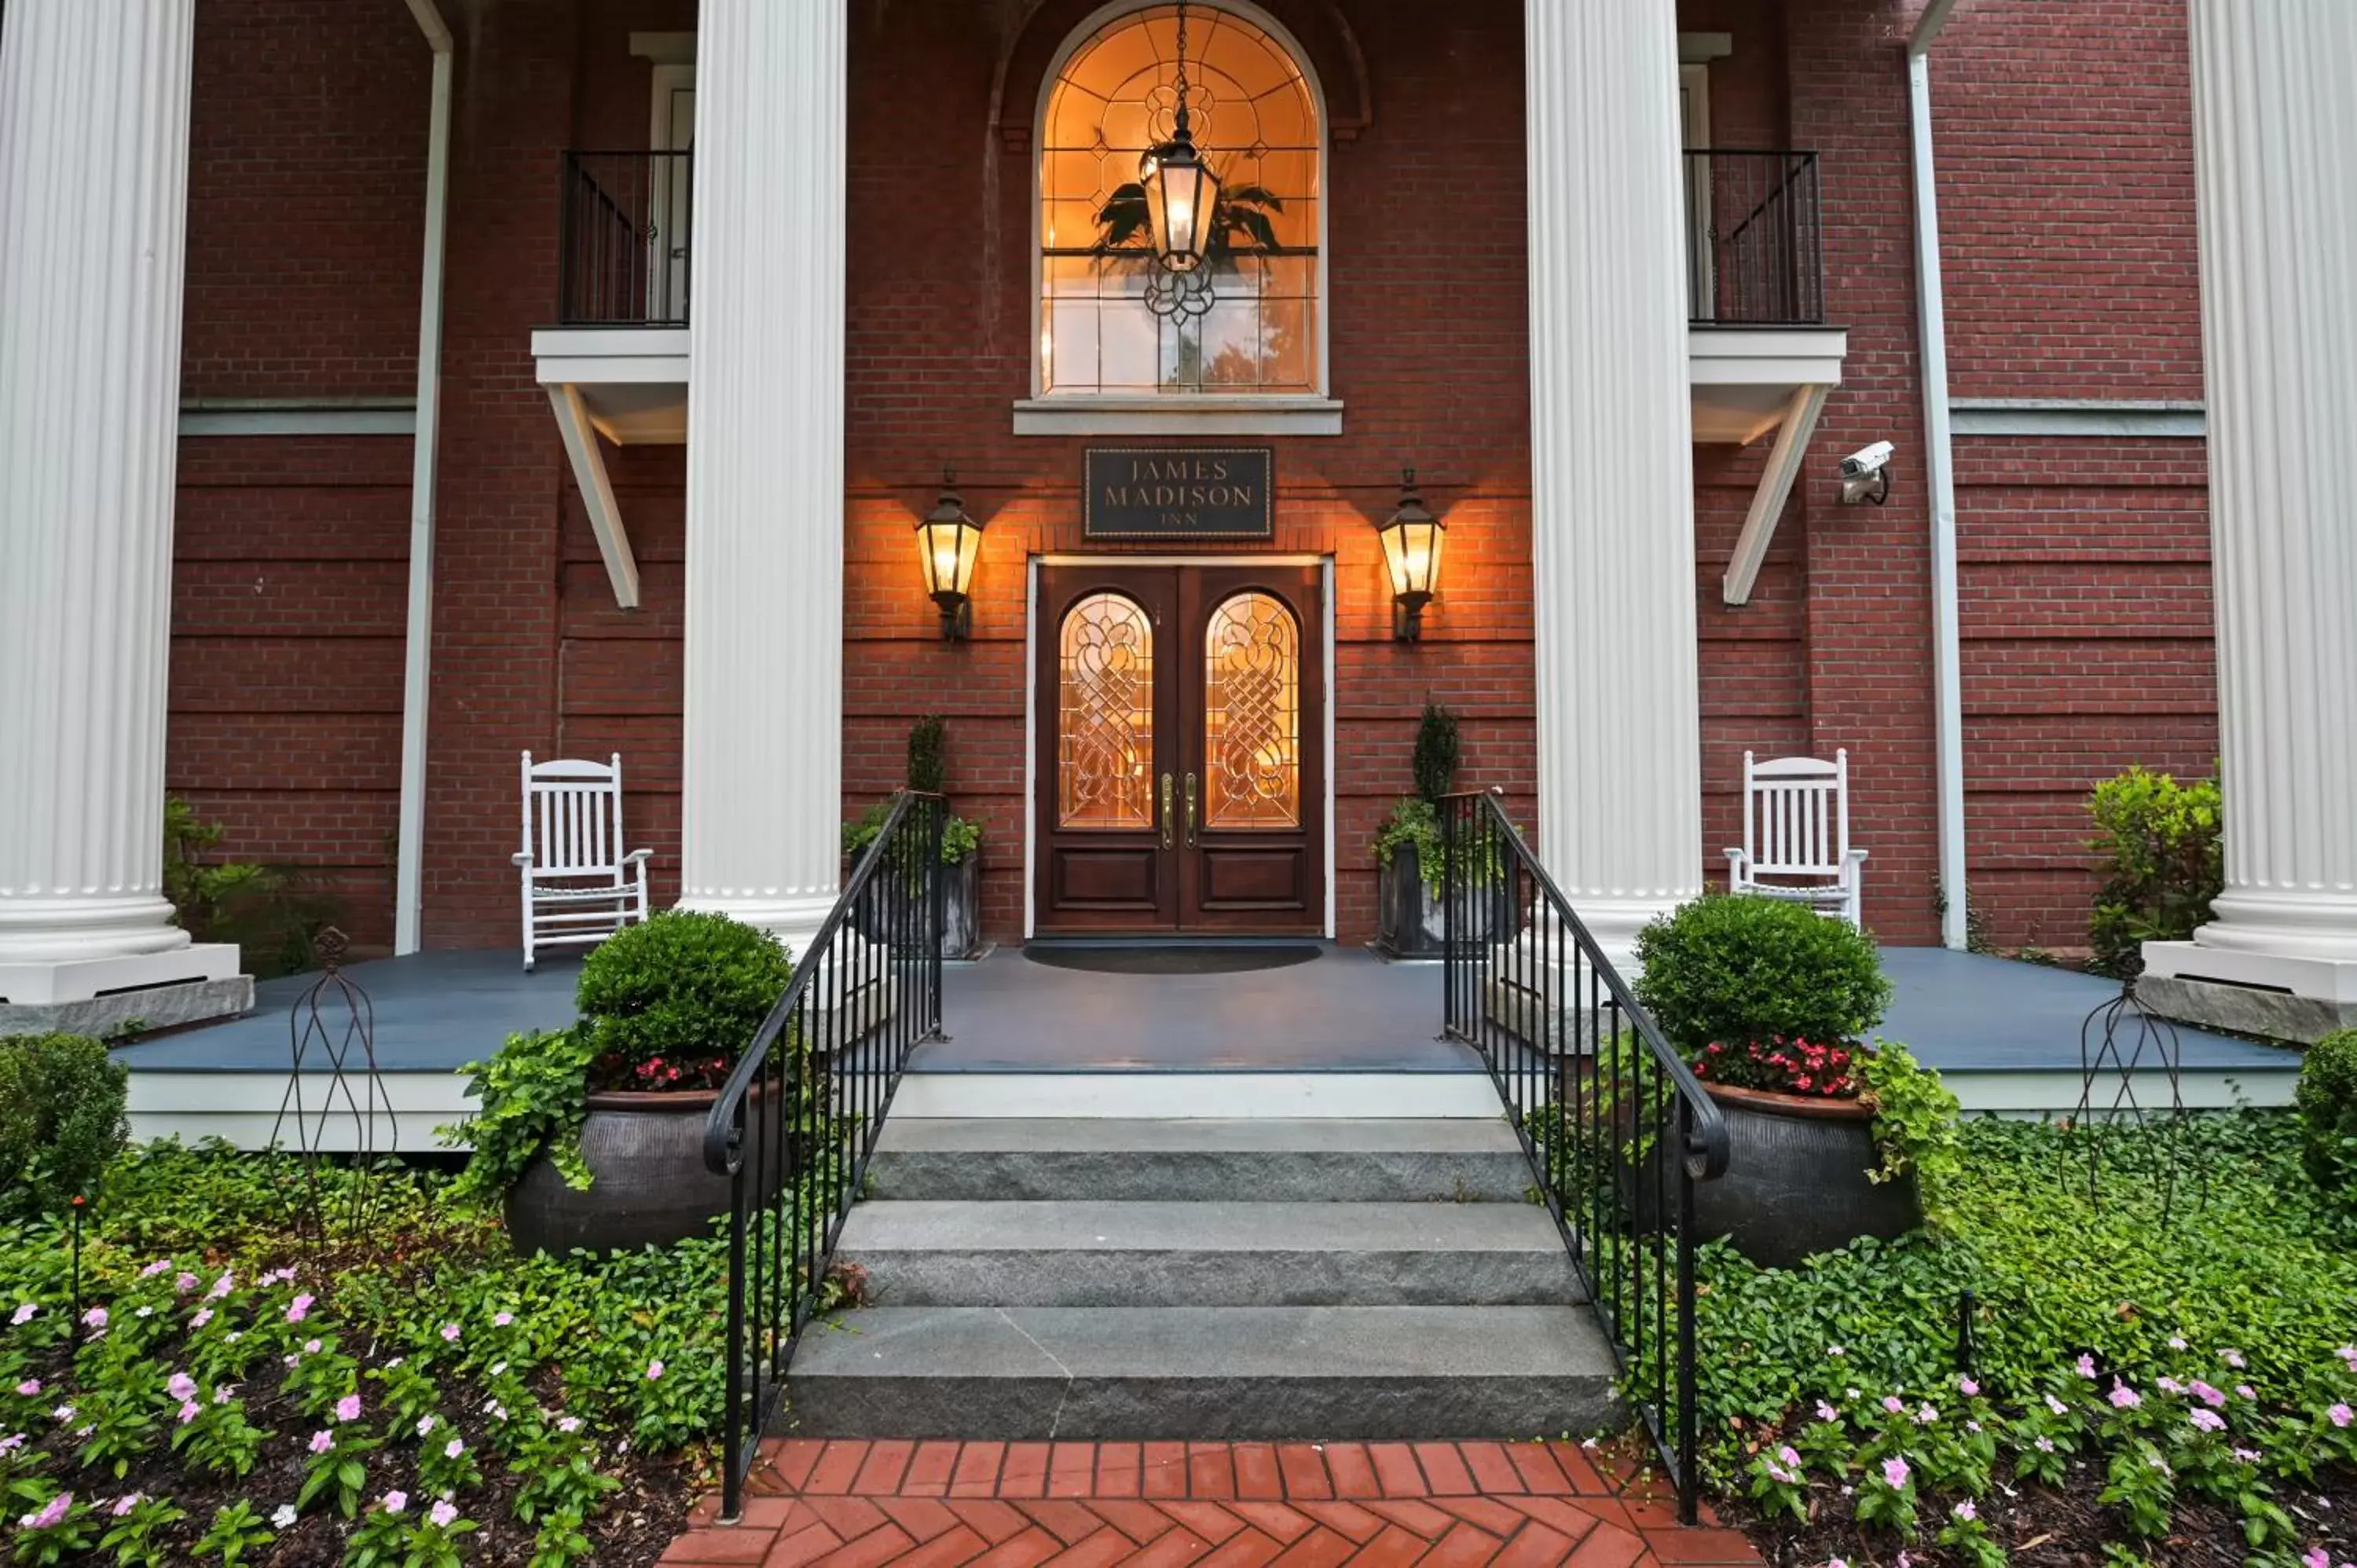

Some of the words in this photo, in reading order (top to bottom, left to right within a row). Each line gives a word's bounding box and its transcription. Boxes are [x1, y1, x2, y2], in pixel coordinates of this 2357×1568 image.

[1132, 459, 1227, 482] JAMES
[1105, 485, 1252, 507] MADISON
[1160, 512, 1197, 526] INN
